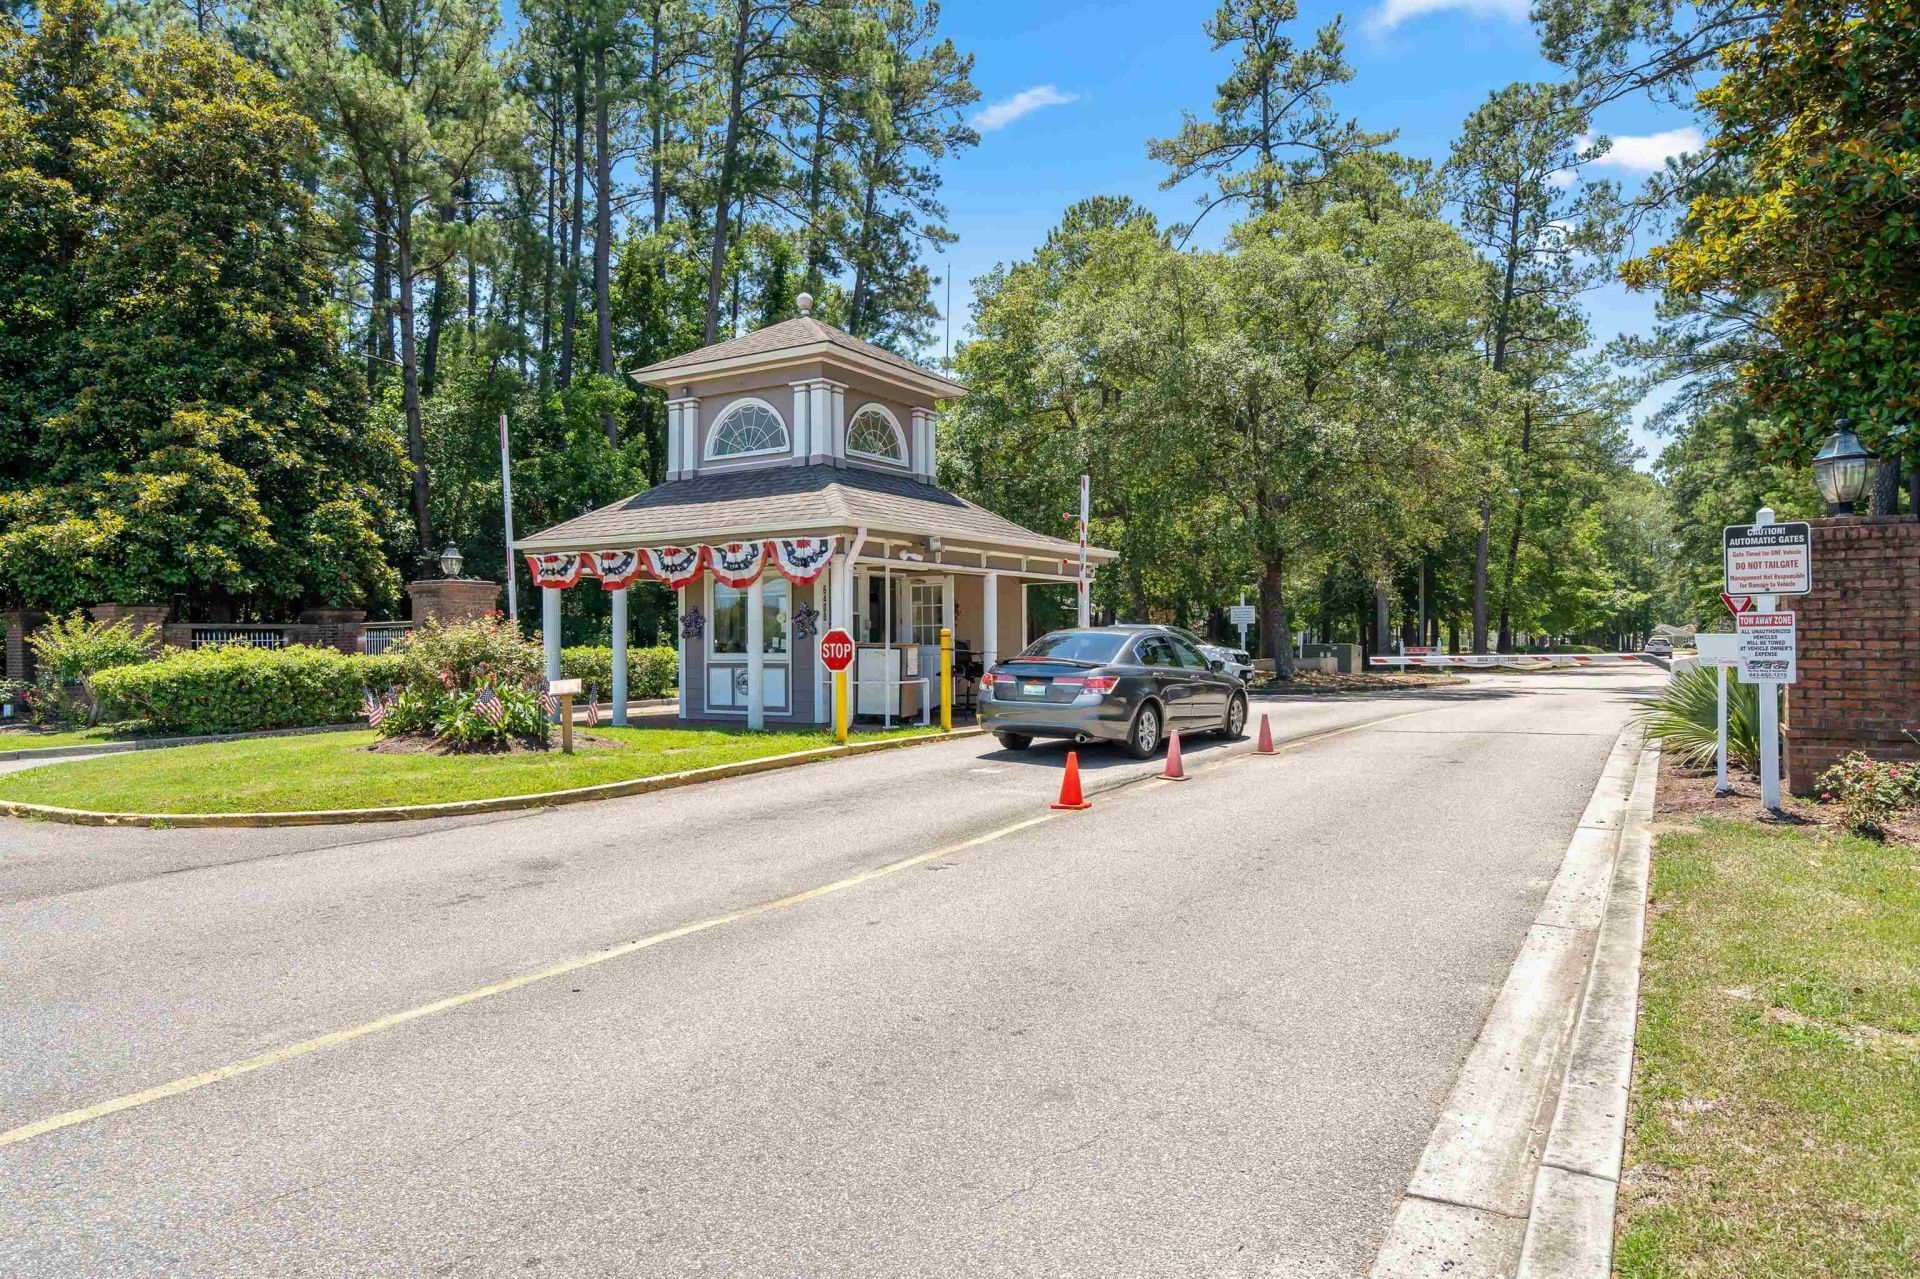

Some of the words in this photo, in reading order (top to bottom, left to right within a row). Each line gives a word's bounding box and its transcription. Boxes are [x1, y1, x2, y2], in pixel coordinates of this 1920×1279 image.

[1747, 527, 1786, 536] CAUTION!
[1730, 537, 1776, 546] AUTOMATIC
[1779, 535, 1805, 543] GATES
[1736, 562, 1746, 570] DO
[1747, 561, 1762, 569] NOT
[1765, 559, 1799, 569] TAILGATE
[1740, 617, 1754, 625] TOW
[1755, 616, 1773, 625] AWAY
[1774, 616, 1791, 624] ZONE
[822, 643, 851, 658] STOP
